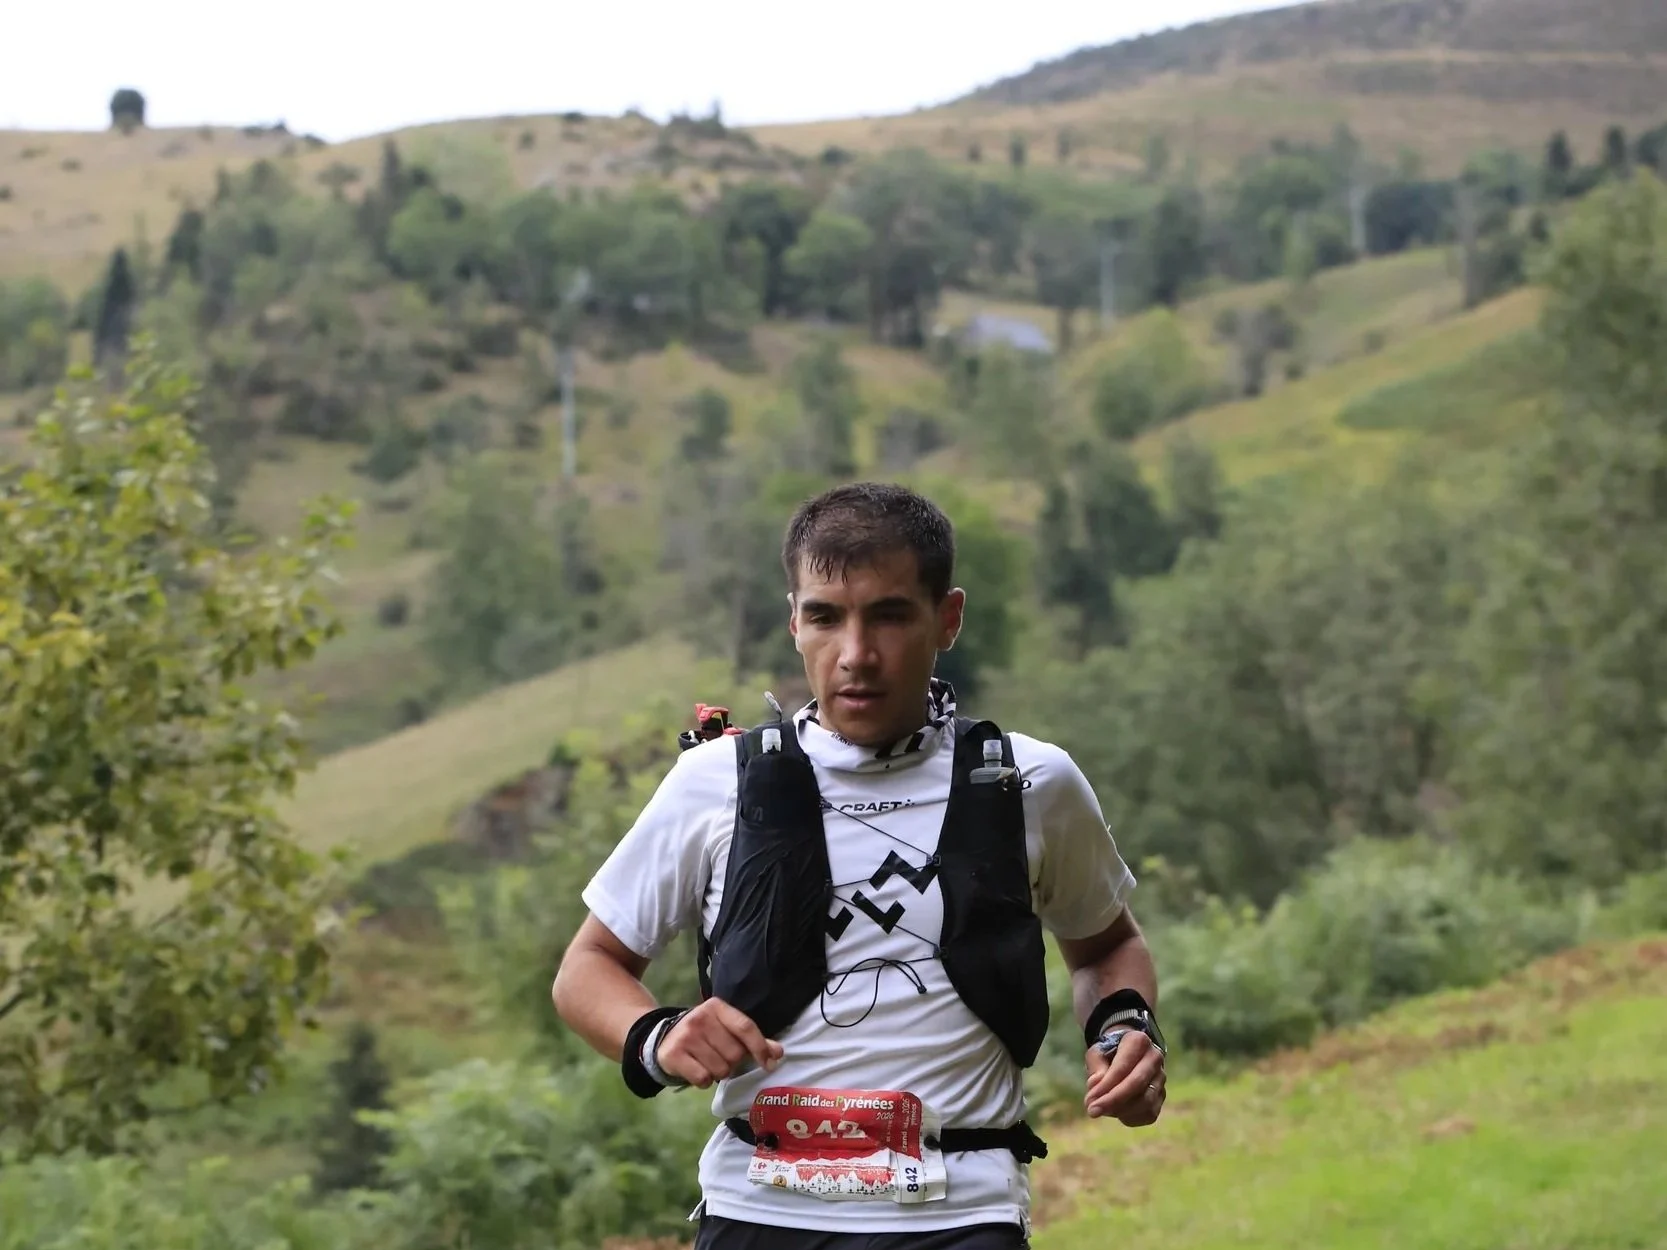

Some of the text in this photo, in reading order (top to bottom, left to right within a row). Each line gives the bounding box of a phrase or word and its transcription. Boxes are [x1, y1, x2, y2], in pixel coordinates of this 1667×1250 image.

[840, 801, 902, 811] CRAFT
[756, 1094, 894, 1111] Grand Raid des Pyrénées
[905, 1167, 919, 1192] 842
